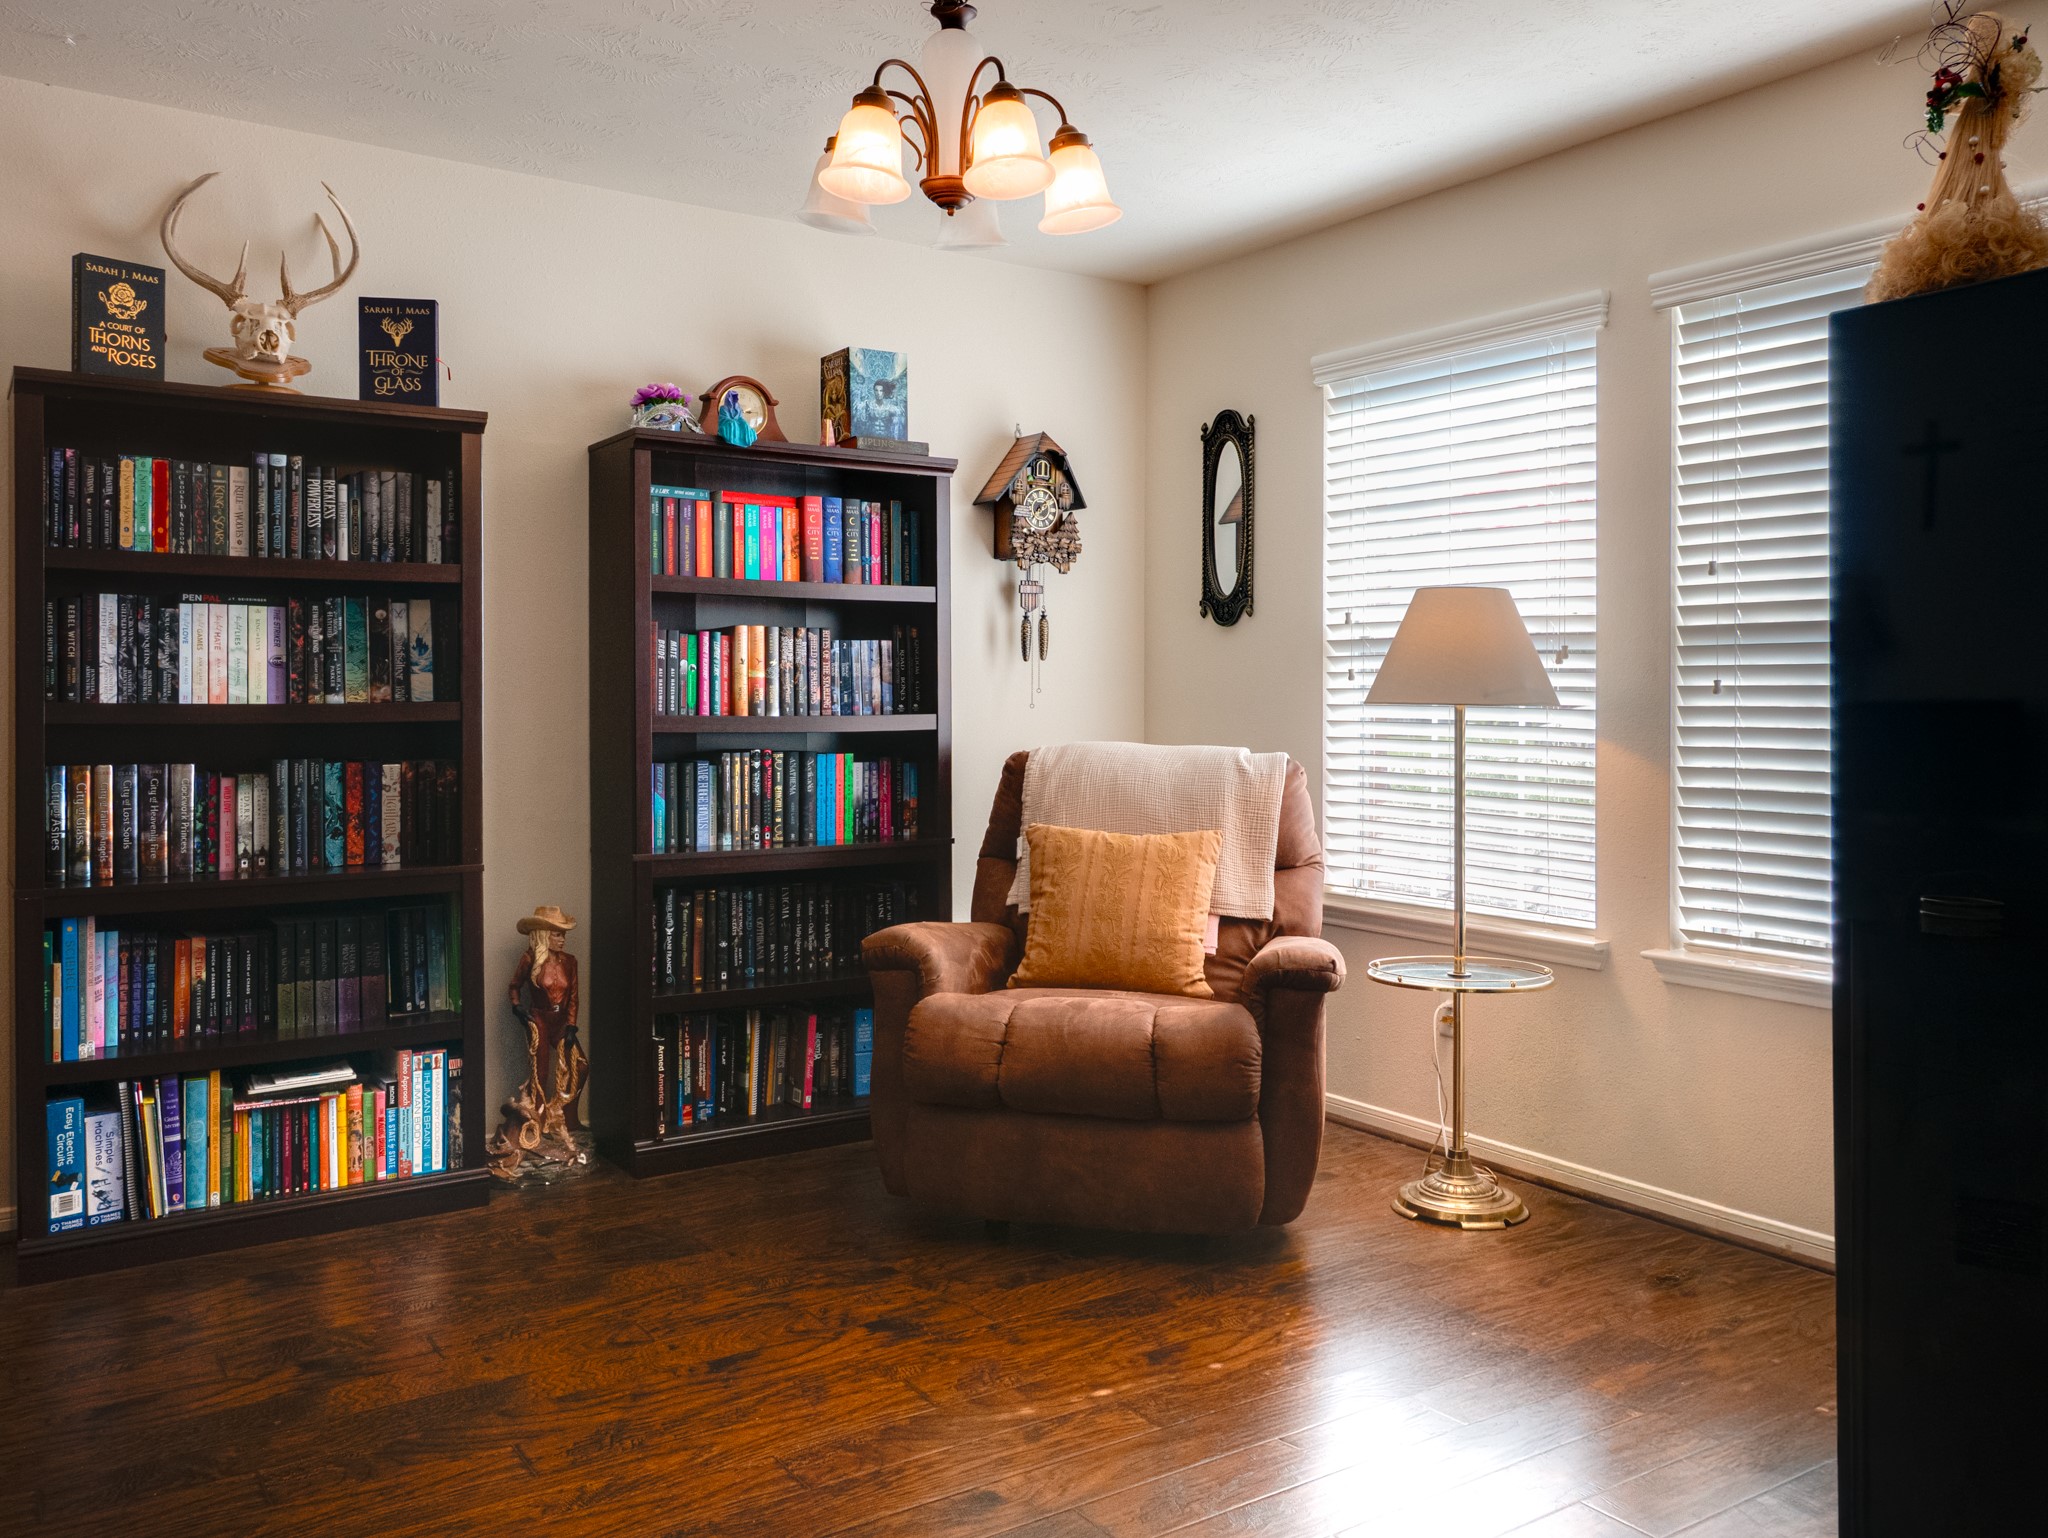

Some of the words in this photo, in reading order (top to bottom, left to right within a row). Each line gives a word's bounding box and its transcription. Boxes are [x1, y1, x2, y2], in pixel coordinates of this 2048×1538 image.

[86, 262, 118, 275] SARAH
[121, 269, 129, 279] J.
[132, 272, 159, 284] MAAS
[364, 305, 393, 314] SARAH
[396, 306, 403, 316] J.
[405, 307, 430, 315] MAAS
[88, 326, 151, 352] THORNS
[99, 321, 106, 329] A
[107, 322, 133, 333] COURT
[134, 326, 146, 335] OF
[91, 345, 108, 354] AND
[108, 347, 157, 369] ROSES
[365, 349, 430, 370] THRONE
[391, 368, 406, 376] OF
[373, 376, 423, 396] GLASS
[858, 437, 897, 449] KIPLING
[213, 484, 226, 508] KING
[234, 485, 245, 505] RULE
[306, 478, 322, 528] POWERLESS
[322, 479, 337, 519] RECKLESS
[213, 515, 226, 546] SCARS
[234, 512, 245, 538] WOLVES
[182, 593, 202, 602] PEN
[202, 594, 221, 603] PAL
[46, 602, 55, 636] HEARTLESS
[67, 604, 77, 628] REBEL
[273, 609, 281, 620] THE
[67, 631, 77, 659] WITCH
[196, 629, 204, 651] GAMES
[214, 632, 222, 651] HATE
[273, 622, 281, 648] STRIKER
[810, 634, 818, 658] SHIELD
[822, 630, 831, 648] RITES
[46, 637, 55, 663] HUNTER
[657, 639, 666, 661] BRIDE
[670, 640, 678, 660] MATE
[822, 650, 831, 660] OF
[822, 661, 831, 674] THE
[810, 670, 818, 705] SPARROWS
[822, 676, 831, 708] STARLING
[148, 778, 160, 795] City
[789, 757, 797, 796] ANATHEMA
[50, 783, 62, 805] City
[73, 782, 87, 805] City
[97, 782, 109, 799] City
[121, 780, 133, 798] City
[180, 778, 190, 820] Clockwork
[224, 786, 233, 799] WILD
[73, 807, 87, 815] of
[121, 808, 133, 825] Lost
[224, 800, 233, 815] LOVE
[384, 796, 401, 839] LIGHTLARK
[73, 817, 87, 846] Glass
[97, 810, 109, 834] Fallen
[148, 805, 160, 842] Heavenly
[50, 819, 62, 851] Ashes
[121, 827, 133, 850] Souls
[180, 822, 190, 854] Princess
[97, 836, 109, 863] Angels
[148, 844, 160, 860] Fire
[781, 887, 790, 919] ENIGMA
[756, 917, 765, 961] GOTHIKANA
[194, 958, 204, 980] FLOCK
[777, 1035, 787, 1068] ANTIBIOTICS
[401, 1056, 411, 1075] Paleo
[401, 1076, 411, 1106] Approach
[414, 1075, 422, 1114] HUMAN
[423, 1074, 432, 1113] HUMAN
[271, 1100, 298, 1108] COWBOY
[388, 1110, 396, 1122] USA
[64, 1107, 75, 1128] Easy
[388, 1124, 396, 1143] STATE
[414, 1117, 422, 1144] BODY
[423, 1115, 432, 1146] BRAIN
[57, 1133, 66, 1167] Circuits
[64, 1131, 75, 1165] Electric
[94, 1121, 104, 1166] Machines
[105, 1131, 115, 1164] Simple
[388, 1151, 396, 1169] STATE
